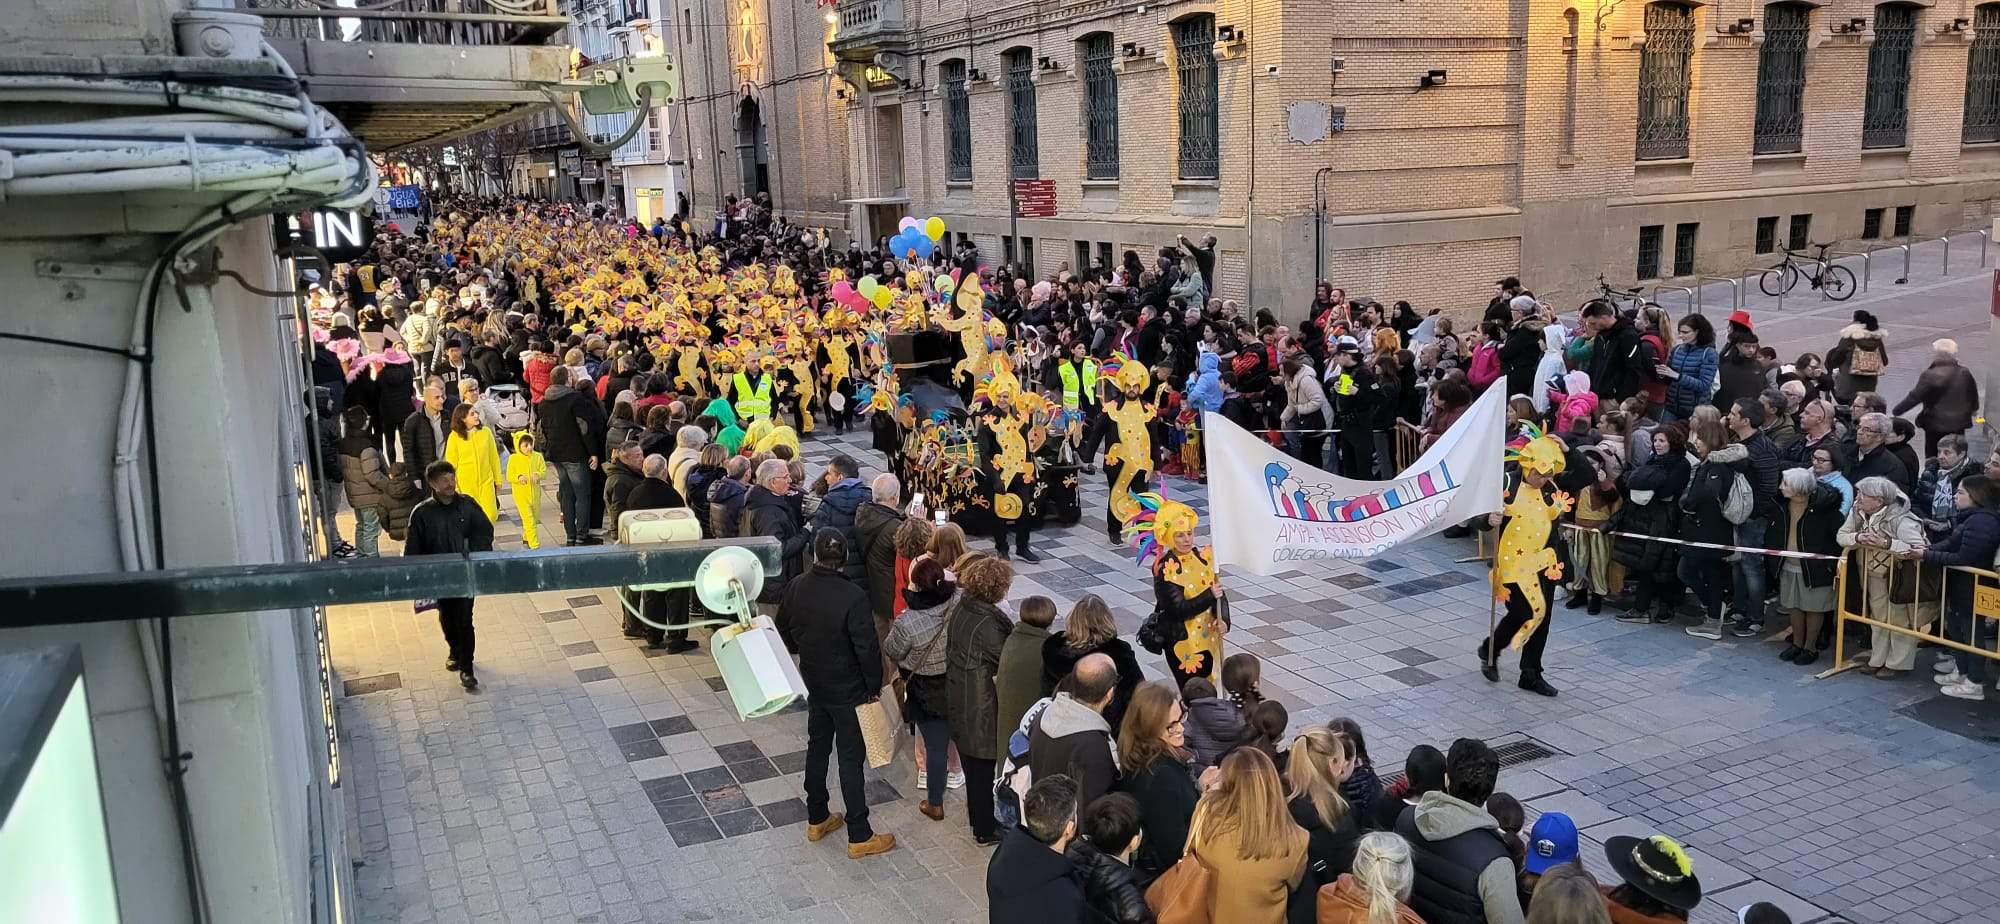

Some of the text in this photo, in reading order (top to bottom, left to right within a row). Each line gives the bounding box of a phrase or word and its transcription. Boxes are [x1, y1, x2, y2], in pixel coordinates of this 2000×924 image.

[313, 211, 362, 248] IN
[1275, 522, 1315, 543] AMPA
[1407, 494, 1457, 528] NICO
[1273, 547, 1327, 563] COLEGIO
